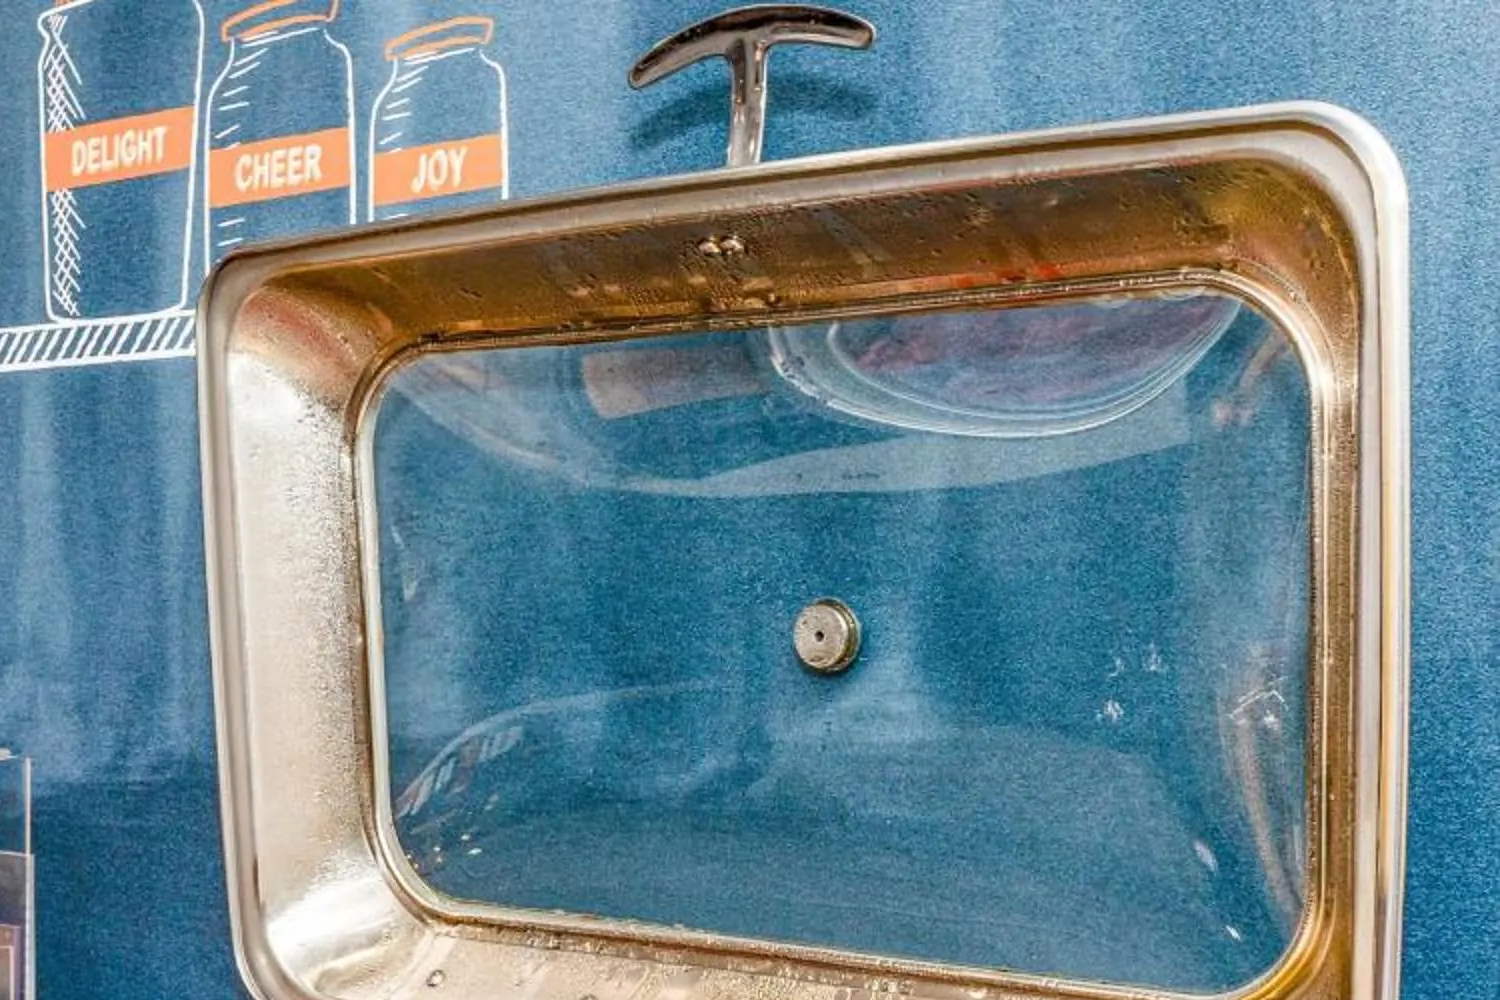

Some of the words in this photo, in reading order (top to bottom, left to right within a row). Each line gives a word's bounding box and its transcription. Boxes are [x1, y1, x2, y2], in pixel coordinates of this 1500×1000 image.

[71, 126, 167, 177] DELIGHT
[235, 142, 323, 192] CHEER
[411, 147, 468, 193] JOY
